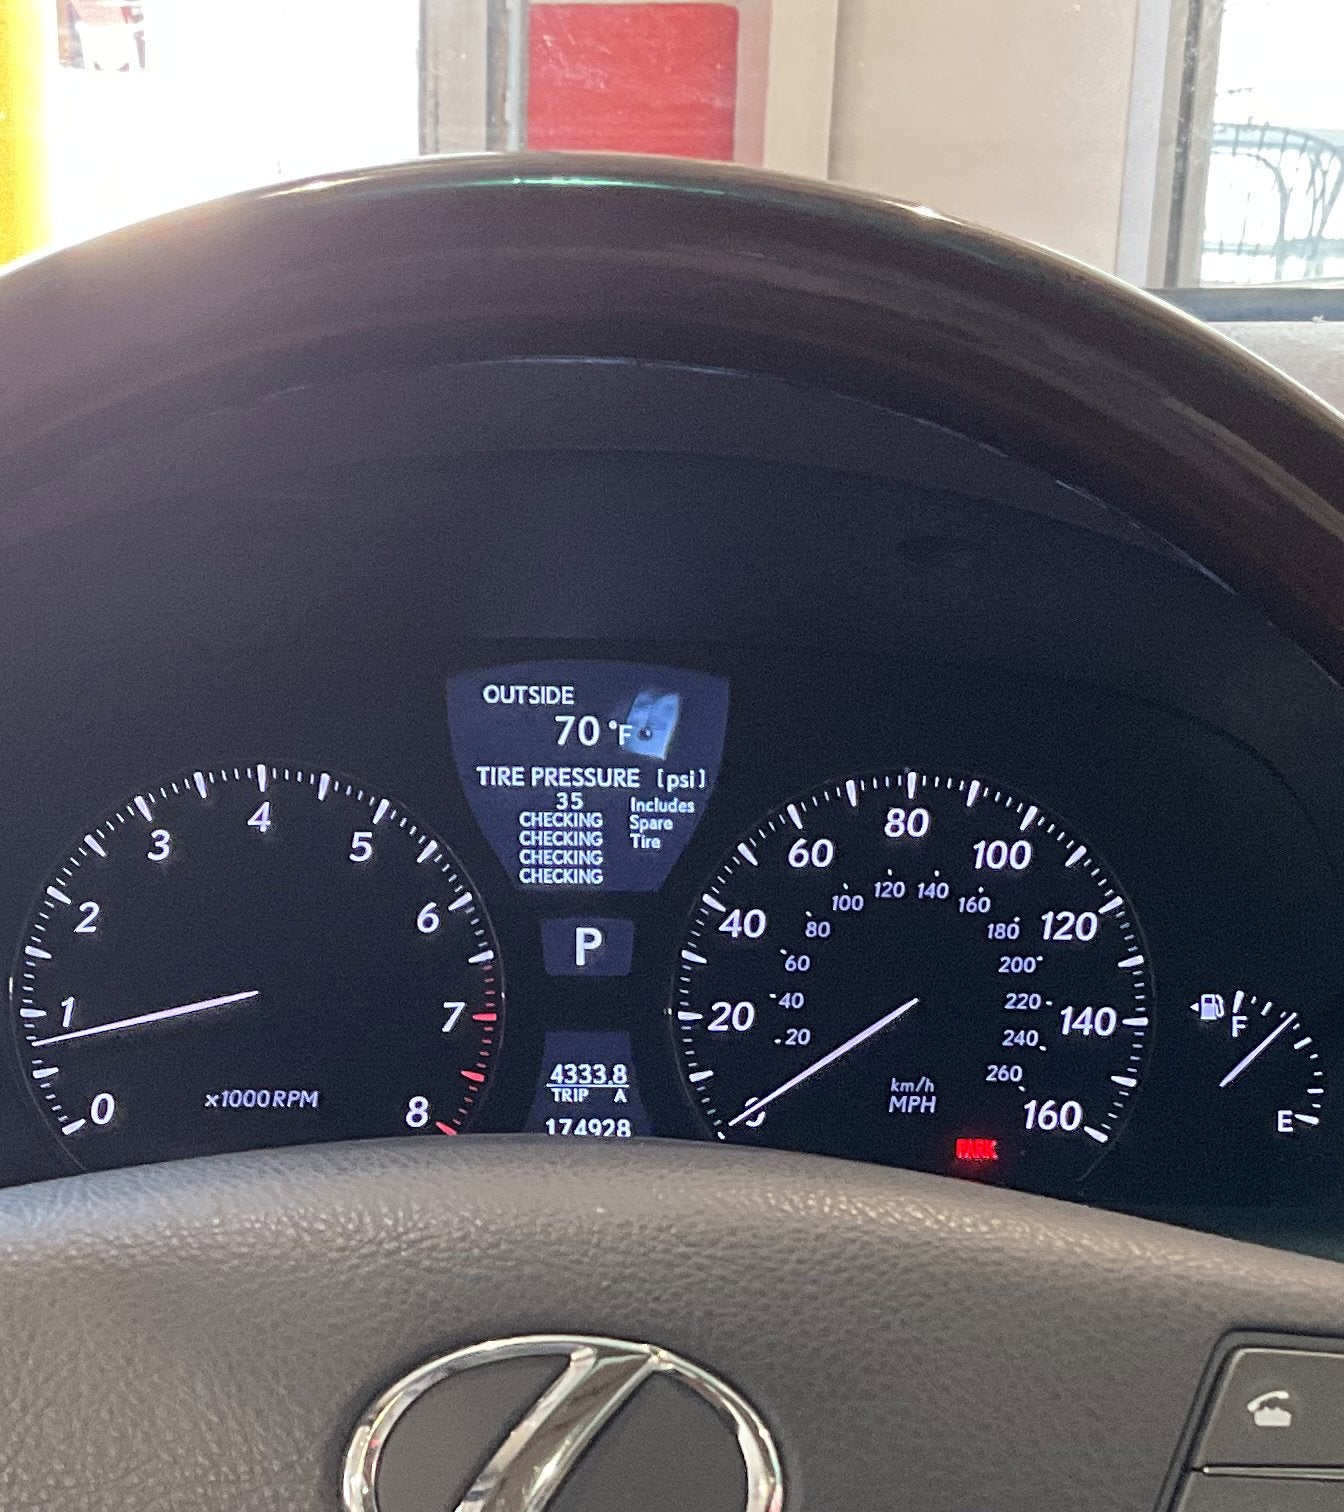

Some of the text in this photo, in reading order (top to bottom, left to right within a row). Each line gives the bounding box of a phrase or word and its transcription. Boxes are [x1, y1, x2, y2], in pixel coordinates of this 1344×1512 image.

[482, 684, 575, 705] OUTSIDE
[554, 715, 600, 746] 70
[476, 765, 525, 787] TIRE
[531, 767, 641, 788] PRESSURE
[556, 792, 584, 811] 35
[629, 796, 696, 813] Includes
[247, 803, 273, 833] 4
[518, 811, 604, 828] CHECKING
[629, 815, 674, 832] Spare
[883, 807, 930, 838] 80
[146, 830, 172, 861] 3
[349, 832, 374, 862] 5
[518, 830, 604, 847] CHECKING
[629, 833, 661, 849] Tire
[518, 849, 604, 866] CHECKING
[787, 838, 834, 869] 60
[972, 840, 1032, 870] 100
[518, 867, 604, 885] CHECKING
[873, 881, 906, 899] 120
[917, 883, 949, 900] 140
[831, 894, 864, 912] 100
[958, 896, 991, 914] 160
[74, 903, 100, 933] 2
[416, 903, 440, 934] 6
[718, 908, 767, 939] 40
[1041, 911, 1098, 941] 120
[805, 921, 831, 938] 80
[987, 923, 1020, 940] 180
[575, 926, 603, 966] P
[784, 955, 811, 972] 60
[998, 956, 1037, 974] 200
[778, 992, 804, 1009] 40
[1004, 993, 1042, 1010] 220
[59, 999, 76, 1028] 1
[442, 1003, 466, 1033] 7
[707, 1001, 755, 1032] 20
[1060, 1006, 1116, 1036] 140
[1231, 1015, 1248, 1038] F
[785, 1028, 811, 1046] 20
[1002, 1029, 1039, 1047] 240
[550, 1063, 628, 1085] 4333.8
[985, 1065, 1023, 1083] 260
[551, 1088, 628, 1103] TRIP A
[890, 1077, 935, 1094] km/h
[90, 1094, 116, 1125] 0
[405, 1097, 430, 1128] 8
[888, 1096, 937, 1114] MPH
[1023, 1100, 1083, 1131] 160
[1277, 1109, 1294, 1133] E
[545, 1118, 632, 1138] 174928
